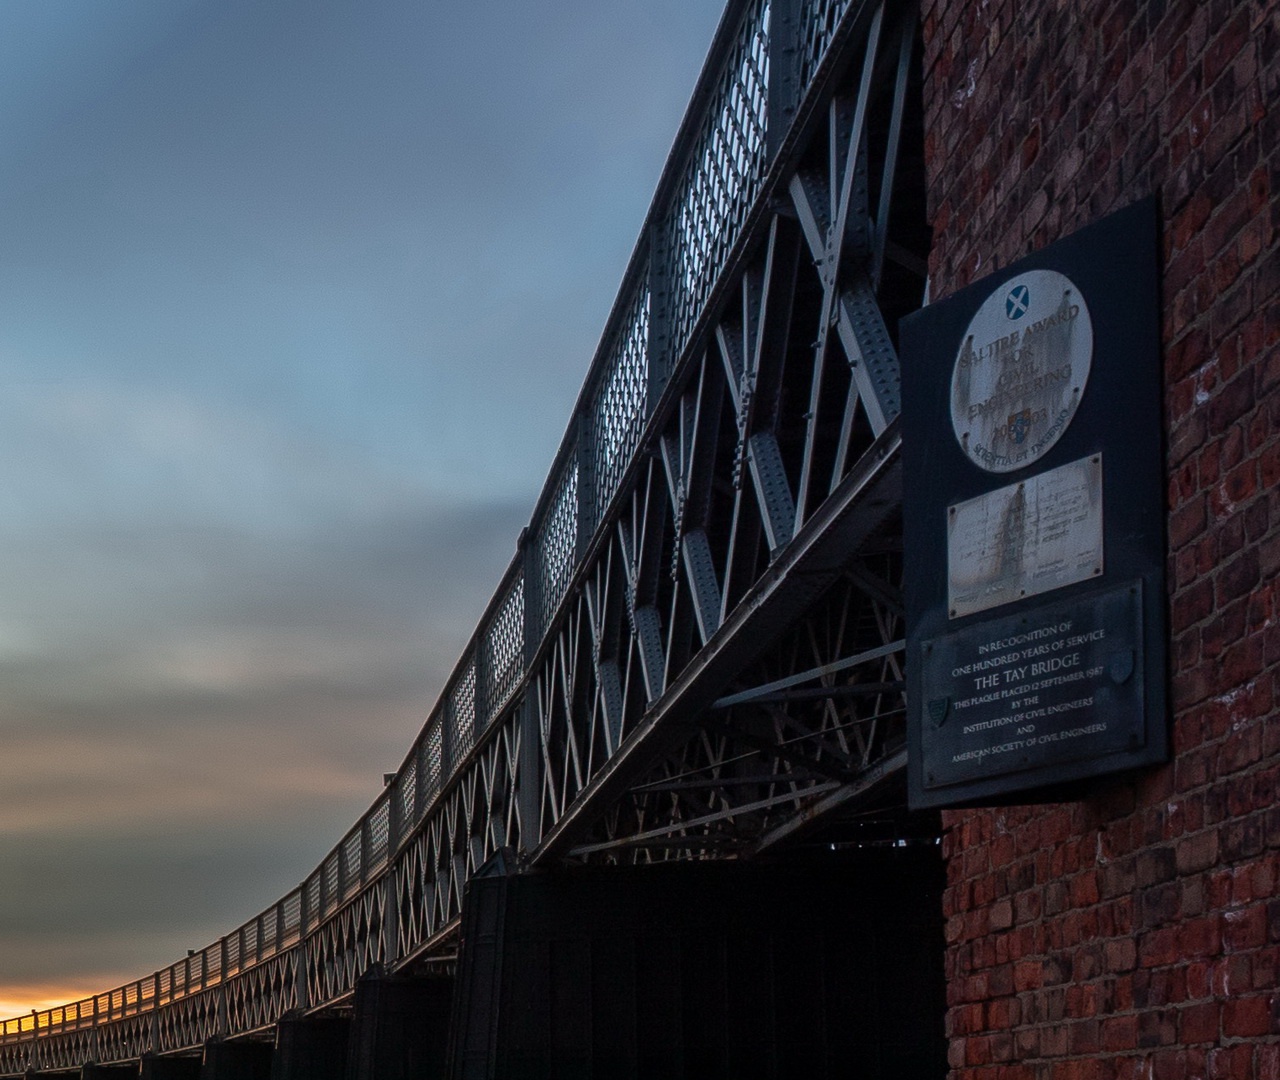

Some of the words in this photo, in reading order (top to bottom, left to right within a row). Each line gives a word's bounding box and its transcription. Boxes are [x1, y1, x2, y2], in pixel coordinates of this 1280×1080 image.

[952, 665, 971, 677] ONE
[973, 652, 1020, 673] HUNDRED
[1021, 644, 1050, 659] YEARS
[1052, 640, 1065, 651] OF
[1066, 629, 1106, 647] SERVICE
[978, 645, 989, 654] IN
[990, 625, 1057, 651] RECOGNITION
[1059, 621, 1073, 632] OF
[974, 673, 1000, 690] THE
[1003, 666, 1028, 683] TAY
[1031, 653, 1080, 676] BRIDGE
[954, 699, 970, 710] THIS
[971, 692, 1000, 705] PLAQUE
[1001, 684, 1031, 698] PLACED
[1031, 683, 1040, 691] 12
[1040, 671, 1085, 689] SEPTEMBER
[1011, 700, 1022, 710] BY
[1023, 696, 1039, 706] THE
[963, 716, 1013, 734] INSTITUTION
[1014, 712, 1025, 723] OF
[1025, 707, 1046, 720] CIVIL
[1047, 697, 1094, 715] ENGINEERS
[1016, 724, 1036, 735] AND
[952, 748, 990, 763] AMERICAN
[991, 740, 1025, 755] SOCIETY
[1026, 737, 1037, 747] OF
[1038, 732, 1059, 745] CIVIL
[1060, 722, 1107, 740] ENGINEERS
